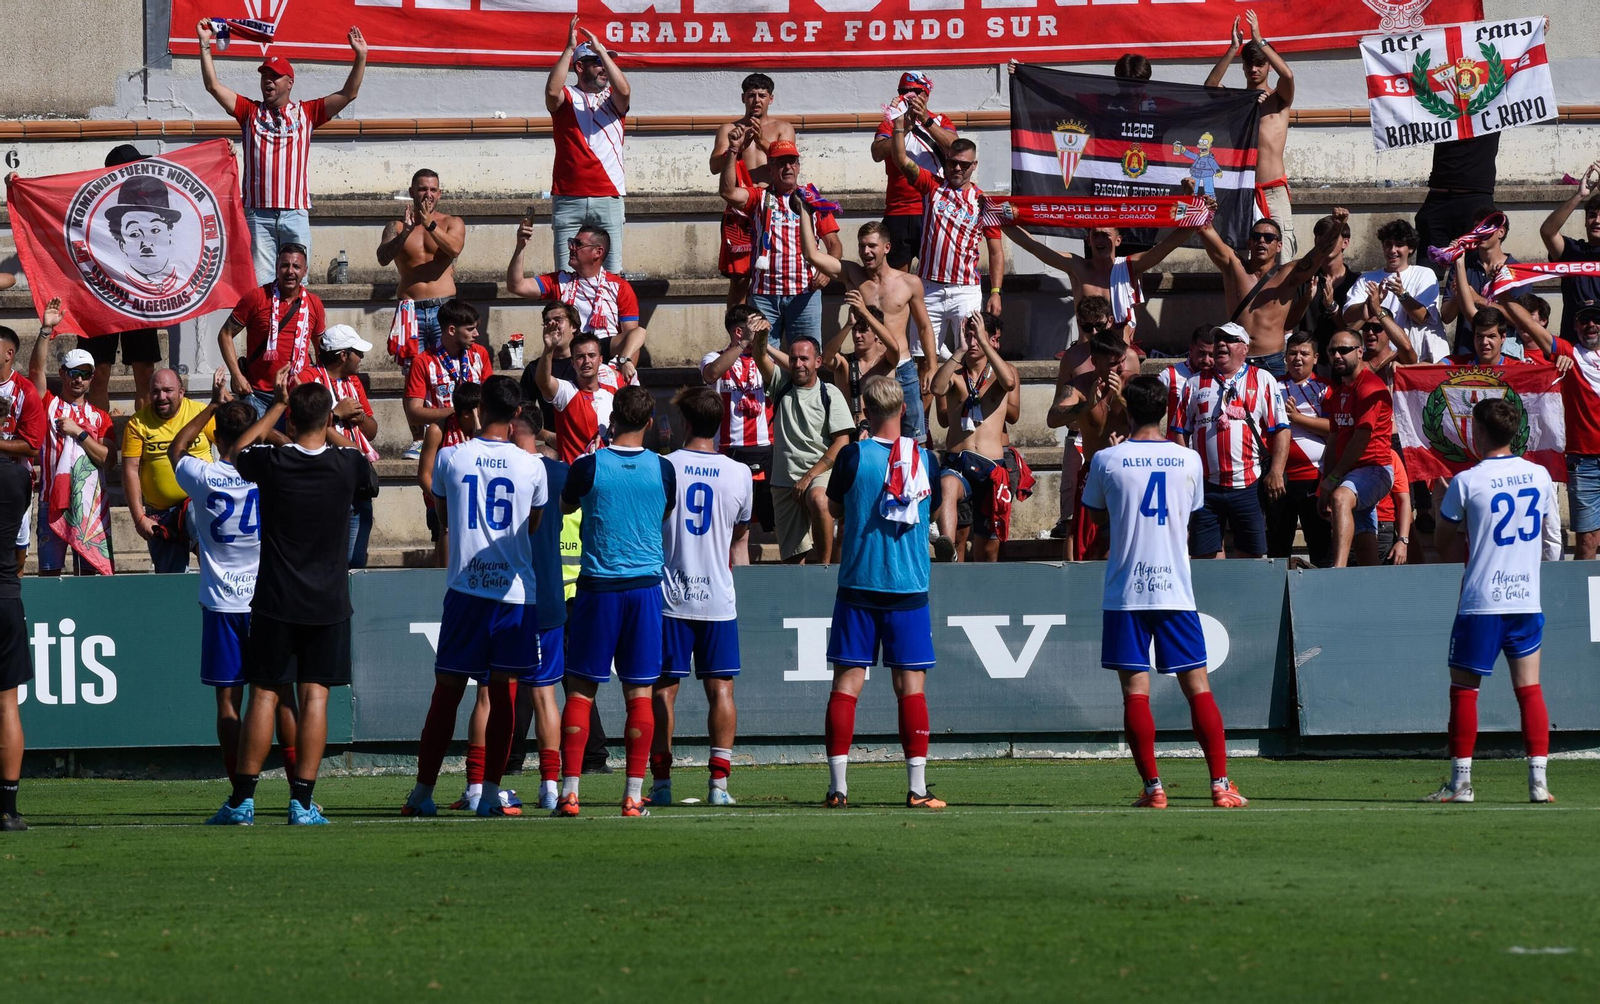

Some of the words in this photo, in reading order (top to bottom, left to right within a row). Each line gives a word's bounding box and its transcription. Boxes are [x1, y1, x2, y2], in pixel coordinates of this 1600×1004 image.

[605, 21, 731, 43] GRADA
[752, 20, 823, 43] ACF
[844, 17, 966, 42] FONDO
[986, 15, 1059, 38] SUR
[1383, 78, 1410, 93] 19
[1120, 122, 1154, 139] 11205
[1385, 120, 1453, 149] BARRIO
[1481, 95, 1548, 131] C.RAYO
[5, 150, 20, 169] 6
[72, 171, 118, 229] KOMANDO
[118, 163, 165, 179] FUENTE
[167, 166, 207, 203] NUEVA
[1093, 182, 1130, 197] PASIÓN
[1131, 186, 1171, 197] ETERNA
[1031, 202, 1048, 212] SÉ
[1051, 204, 1092, 212] PARTE
[1094, 204, 1117, 212] DEL
[1120, 203, 1157, 212] ÉXITO
[1118, 212, 1155, 220] CORAZÓN
[203, 213, 219, 241] KFN
[132, 290, 192, 313] ALGECIRAS
[475, 455, 508, 469] ÁNGEL
[684, 465, 720, 478] MANIN
[1122, 457, 1152, 468] ALEIX
[1491, 478, 1503, 489] JJ
[1507, 473, 1534, 487] RILEY
[461, 474, 515, 531] 16
[1140, 471, 1169, 526] 4
[206, 488, 261, 543] 24
[685, 482, 714, 536] 9
[1490, 487, 1541, 547] 23
[468, 557, 510, 576] Algeciras
[1133, 561, 1172, 581] Algeciras
[482, 576, 510, 588] Gusta
[672, 569, 711, 589] Algeciras
[1147, 577, 1172, 593] Gusta
[1491, 570, 1530, 589] Algeciras
[684, 587, 710, 601] Gusta
[1505, 586, 1530, 600] Gusta
